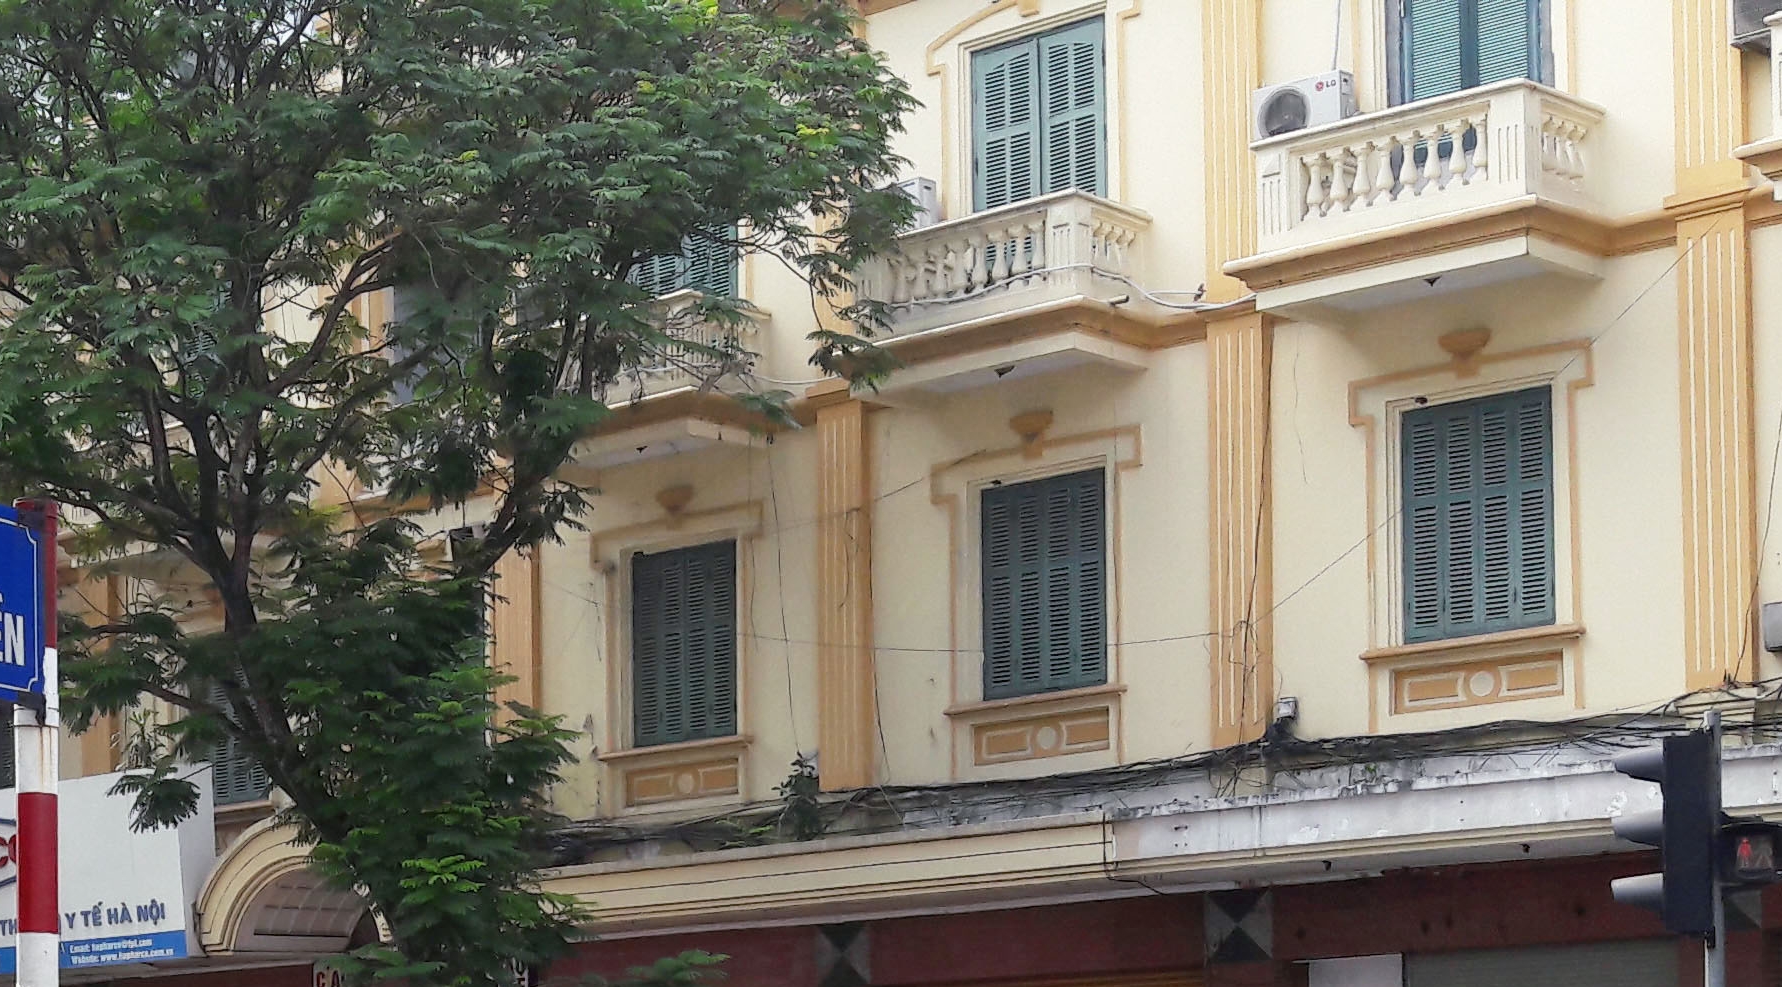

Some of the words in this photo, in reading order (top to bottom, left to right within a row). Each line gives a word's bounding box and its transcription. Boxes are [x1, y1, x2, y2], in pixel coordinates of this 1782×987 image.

[64, 911, 76, 929] Y
[79, 901, 103, 927] TẾ
[106, 901, 132, 926] HÀ
[136, 898, 166, 926] NỘI
